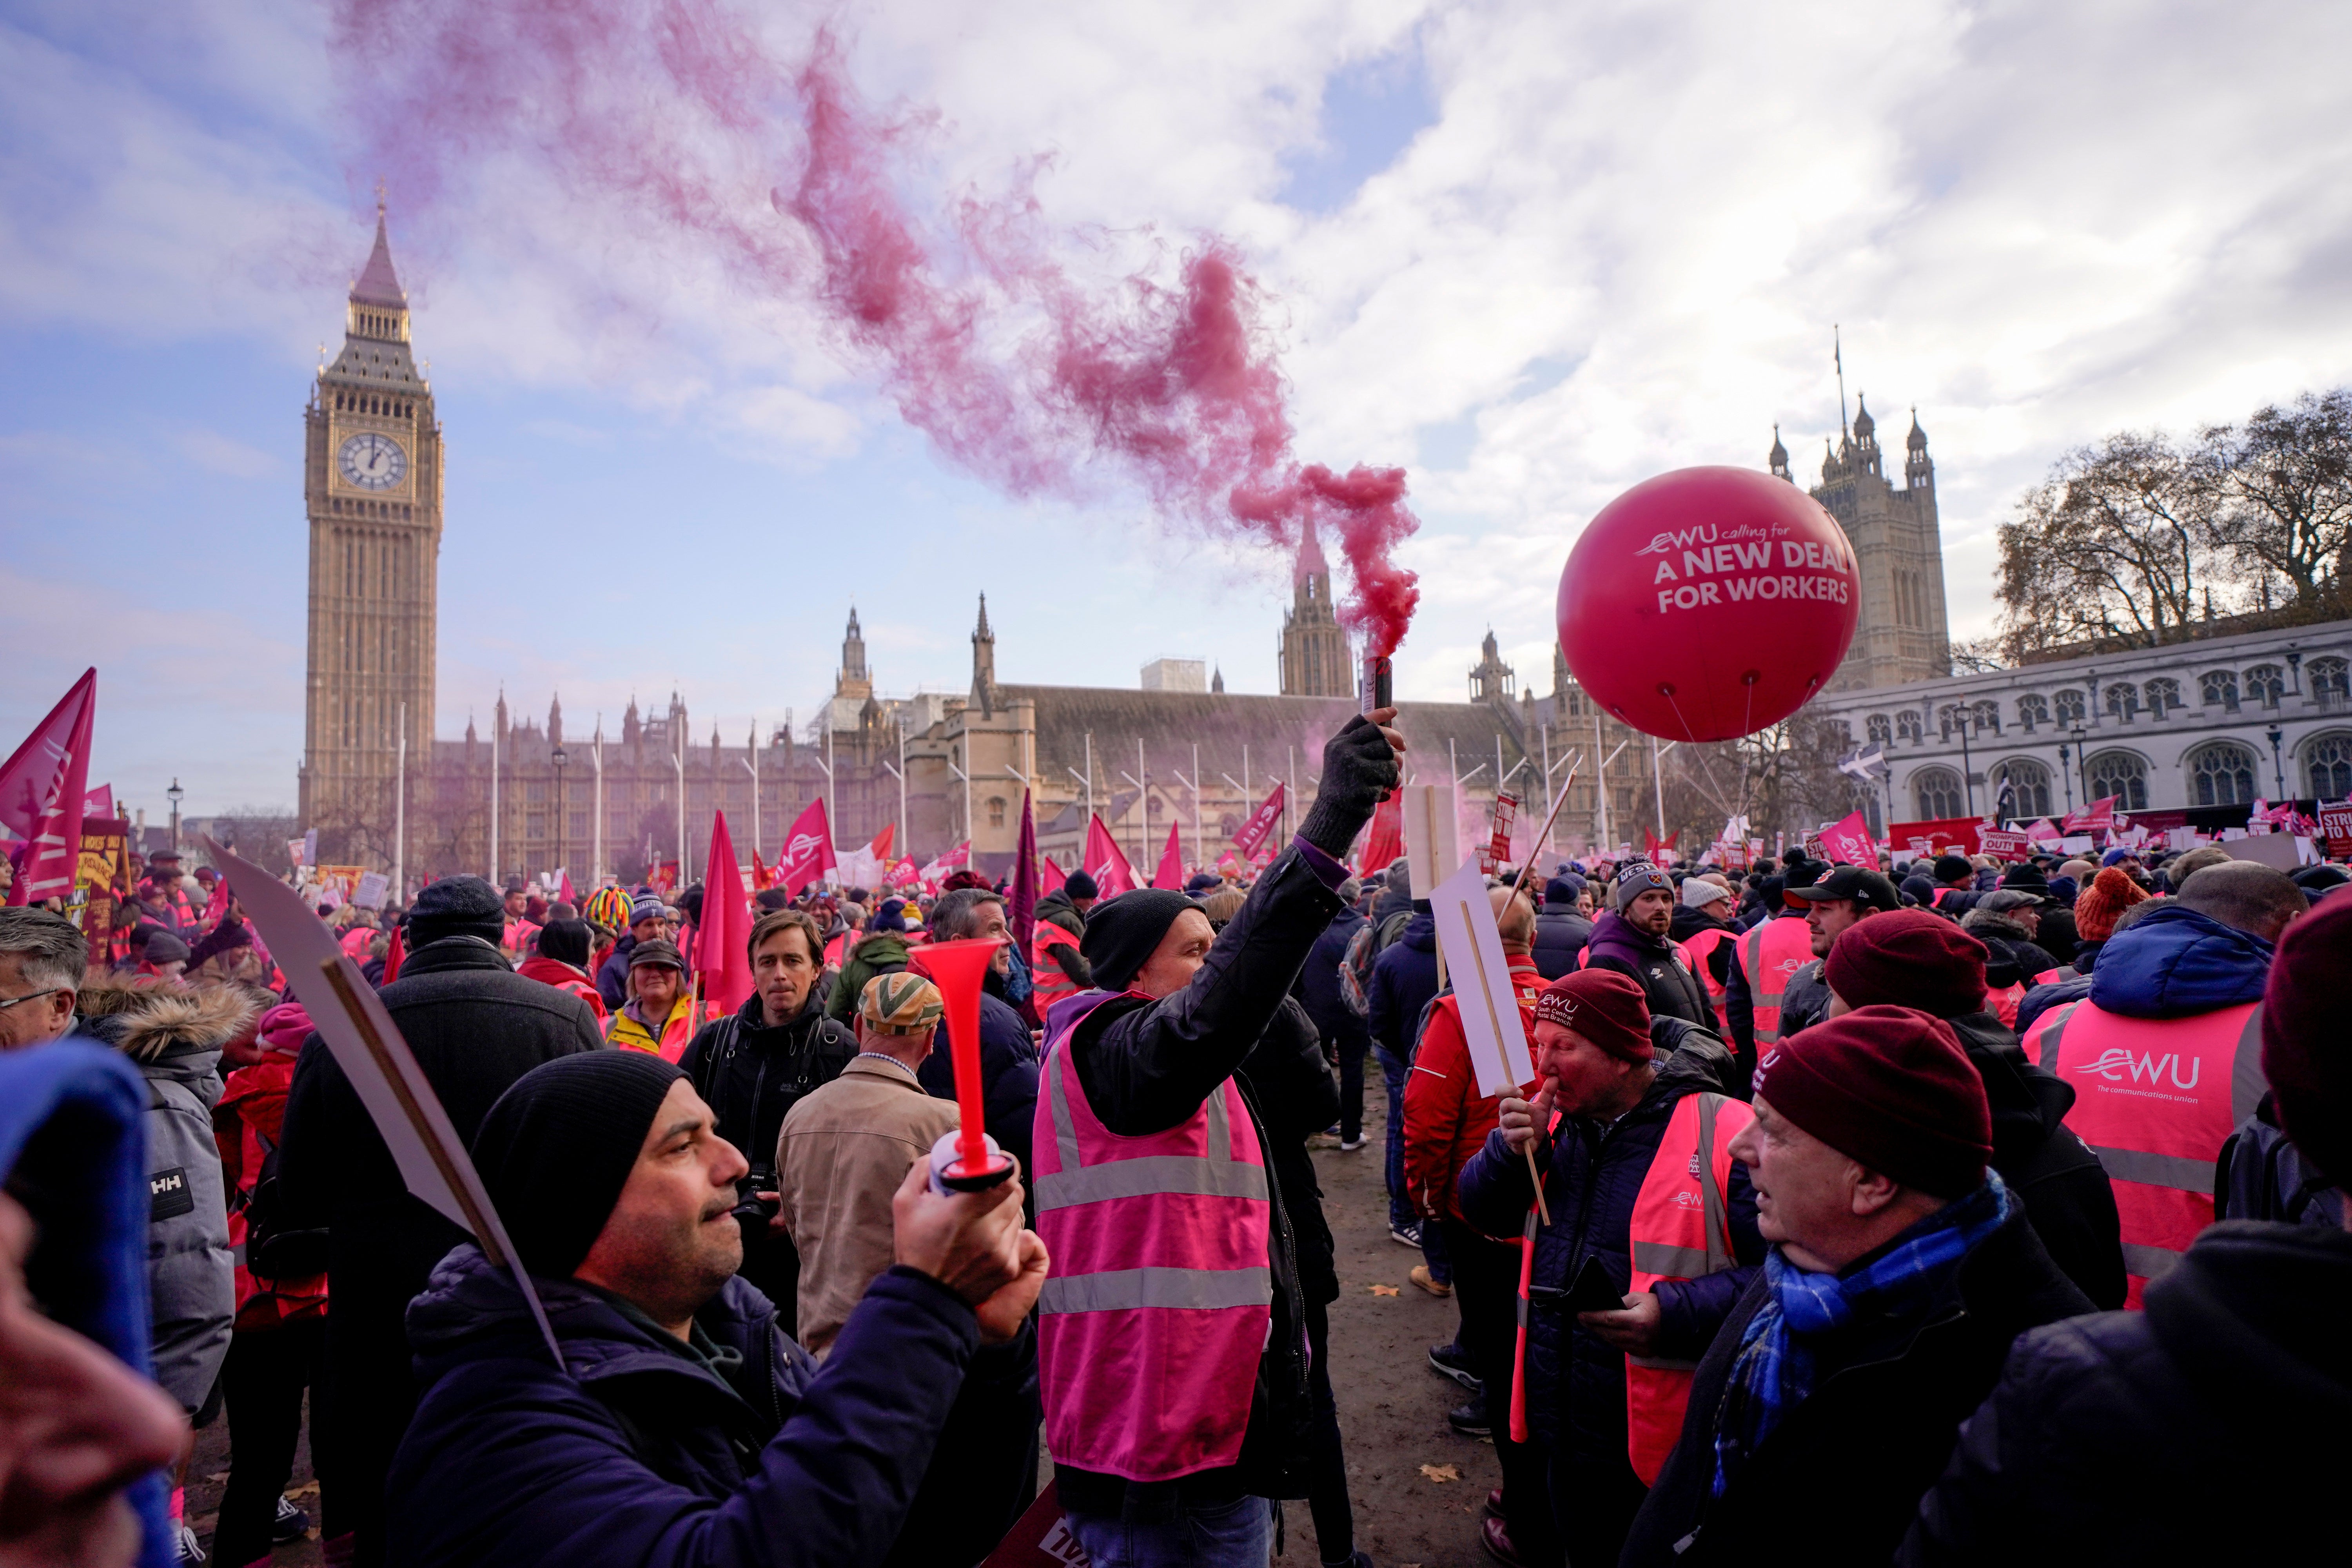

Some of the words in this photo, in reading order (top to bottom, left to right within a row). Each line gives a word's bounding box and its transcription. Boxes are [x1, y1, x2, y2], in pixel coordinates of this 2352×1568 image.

[1633, 523, 1718, 557] CWU
[1722, 524, 1766, 544] calling
[1771, 522, 1790, 537] for
[1654, 560, 1679, 585] A
[1683, 541, 1772, 578] NEW
[1781, 541, 1848, 575] DEAL
[1658, 581, 1723, 614] FOR
[1724, 575, 1848, 605] WORKERS
[1497, 801, 1515, 822] STRIKE
[2323, 812, 2352, 827] STRI
[1495, 817, 1503, 834] TO
[2326, 826, 2343, 839] TO
[1986, 832, 2025, 842] THOMPSON
[1986, 840, 2012, 850] OUT!
[1475, 849, 1490, 859] STRIK
[1620, 865, 1651, 882] WEST
[633, 901, 664, 910] TOTTENH
[1772, 958, 1813, 973] CW
[1539, 994, 1578, 1013] CWU
[1550, 1014, 1571, 1027] Branch
[1551, 1008, 1573, 1021] Central
[2073, 1048, 2200, 1089] CWU
[2110, 1087, 2172, 1100] communications
[2174, 1095, 2198, 1104] union
[151, 1174, 181, 1194] HH
[1667, 1191, 1703, 1207] CW
